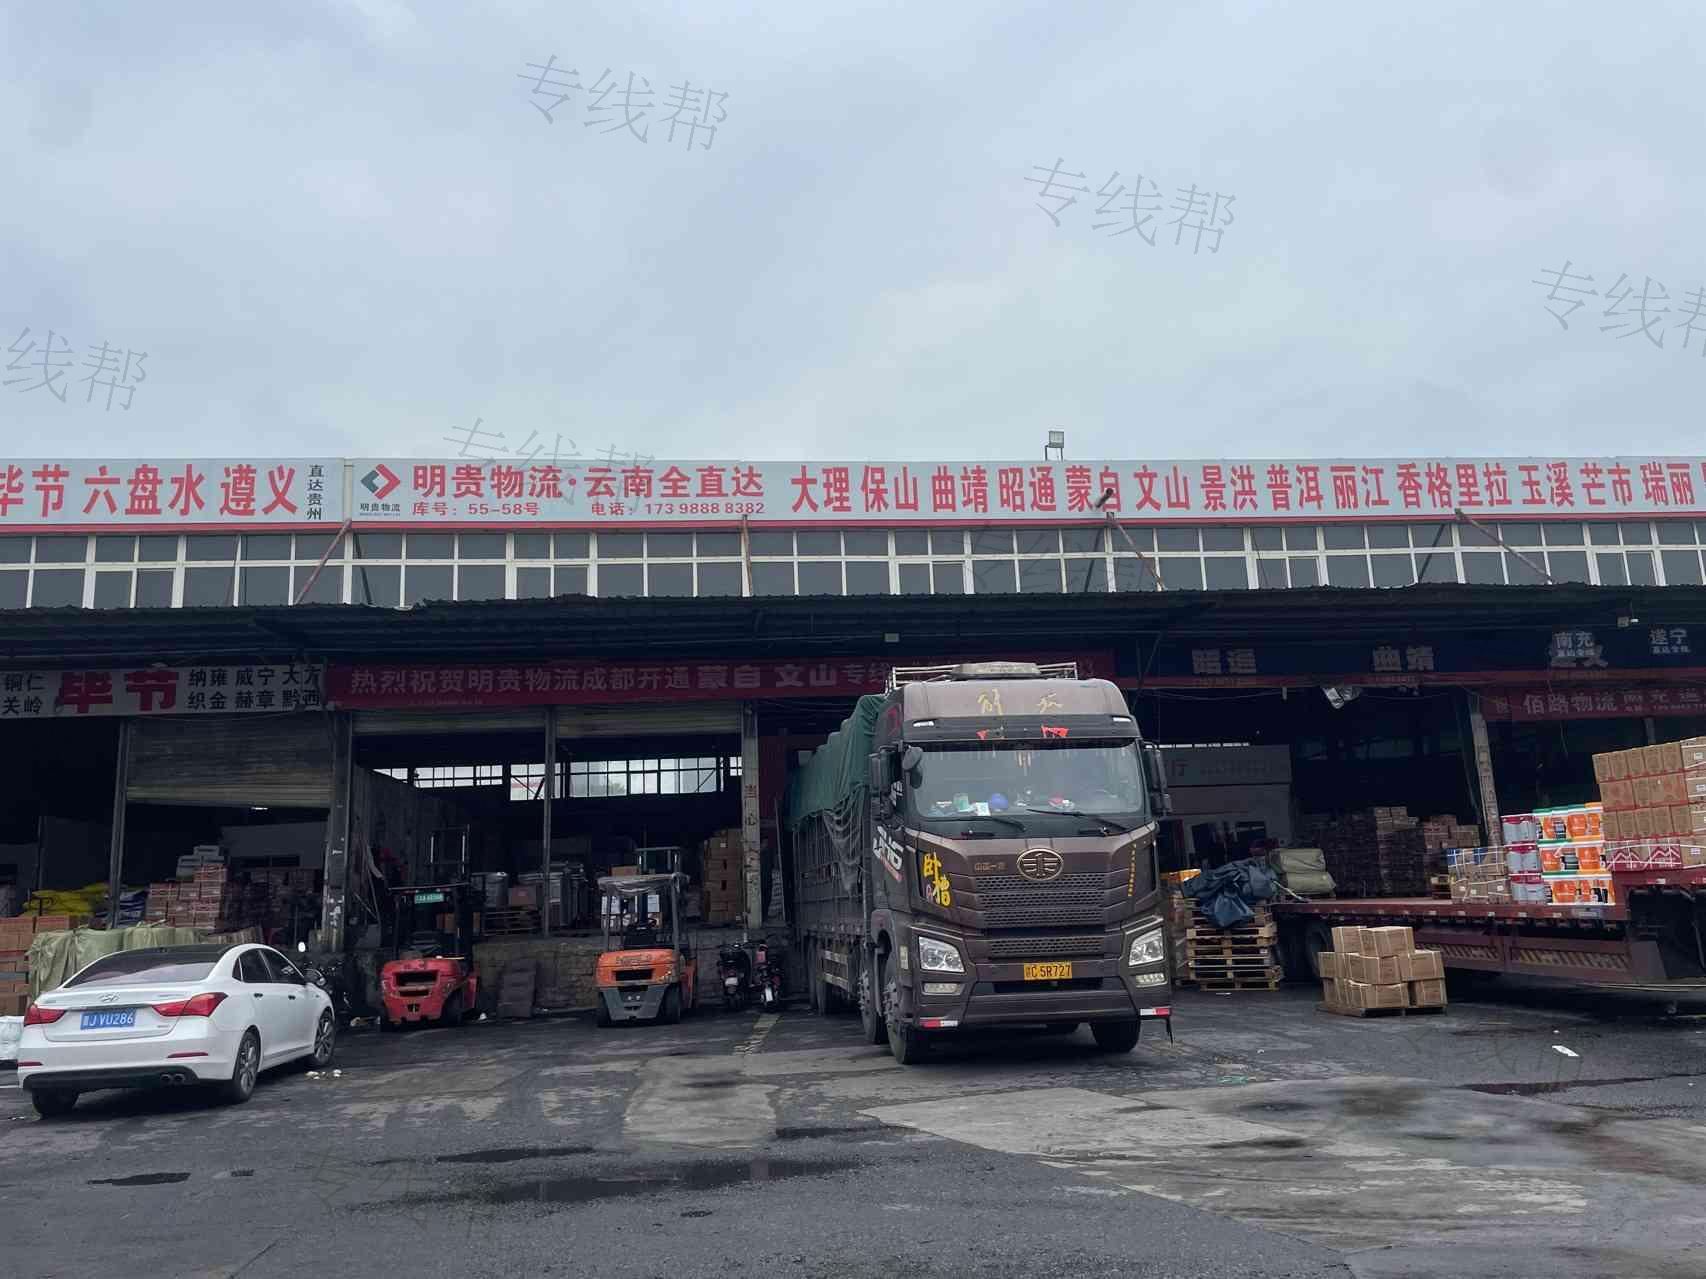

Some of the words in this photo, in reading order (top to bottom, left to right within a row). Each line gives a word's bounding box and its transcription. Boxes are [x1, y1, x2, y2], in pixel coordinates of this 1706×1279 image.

[0, 464, 70, 517] 毕节
[83, 464, 205, 516] 六盘水
[219, 464, 297, 516] 遵义
[306, 464, 325, 521] 直达贵州
[412, 464, 764, 499] 明贵物流·云南全直达
[791, 465, 852, 512] 大理
[860, 465, 920, 512] 保山
[931, 465, 989, 513] 曲靖
[998, 467, 1057, 512] 昭通
[1065, 465, 1121, 512] 蒙自
[1133, 464, 1191, 512] 文山
[1200, 464, 1258, 512] 景洪
[1266, 464, 1324, 511] 普洱
[1330, 464, 1390, 509] 丽江
[1398, 462, 1512, 509] 香格里拉
[1518, 462, 1574, 508] 玉溪
[1580, 462, 1633, 506] 芒市
[1640, 461, 1696, 506] 瑞丽
[359, 503, 401, 512] 明贵物流
[679, 503, 720, 515] 9888
[724, 502, 765, 515] 8382
[1553, 631, 1595, 648] 南充
[187, 667, 229, 687] 纳雍
[235, 666, 276, 686] 威宁
[281, 663, 321, 685] 大方
[57, 669, 180, 713] 毕节
[187, 690, 228, 710] 织金
[235, 690, 275, 710] 赫章
[281, 688, 321, 708] 黔西
[2, 695, 43, 714] 关岭
